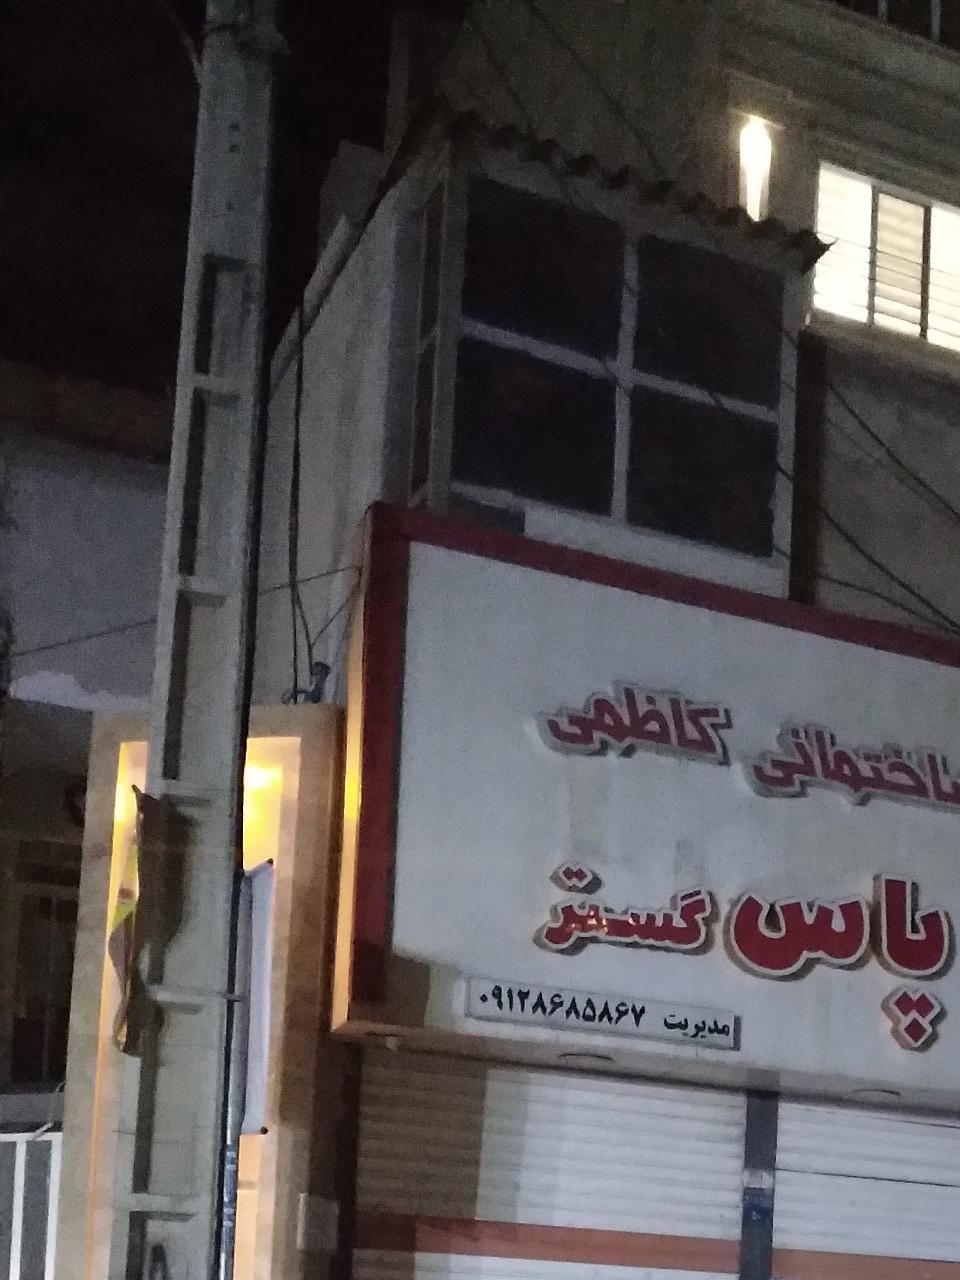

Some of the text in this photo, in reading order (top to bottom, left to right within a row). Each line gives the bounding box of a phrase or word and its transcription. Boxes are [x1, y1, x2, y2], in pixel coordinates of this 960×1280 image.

[546, 686, 724, 754] کاظمی
[541, 863, 952, 1048] پاس گستر
[479, 984, 730, 1039] مدیریت ۰۹۱۲۸۶۸۵۸۶۷
